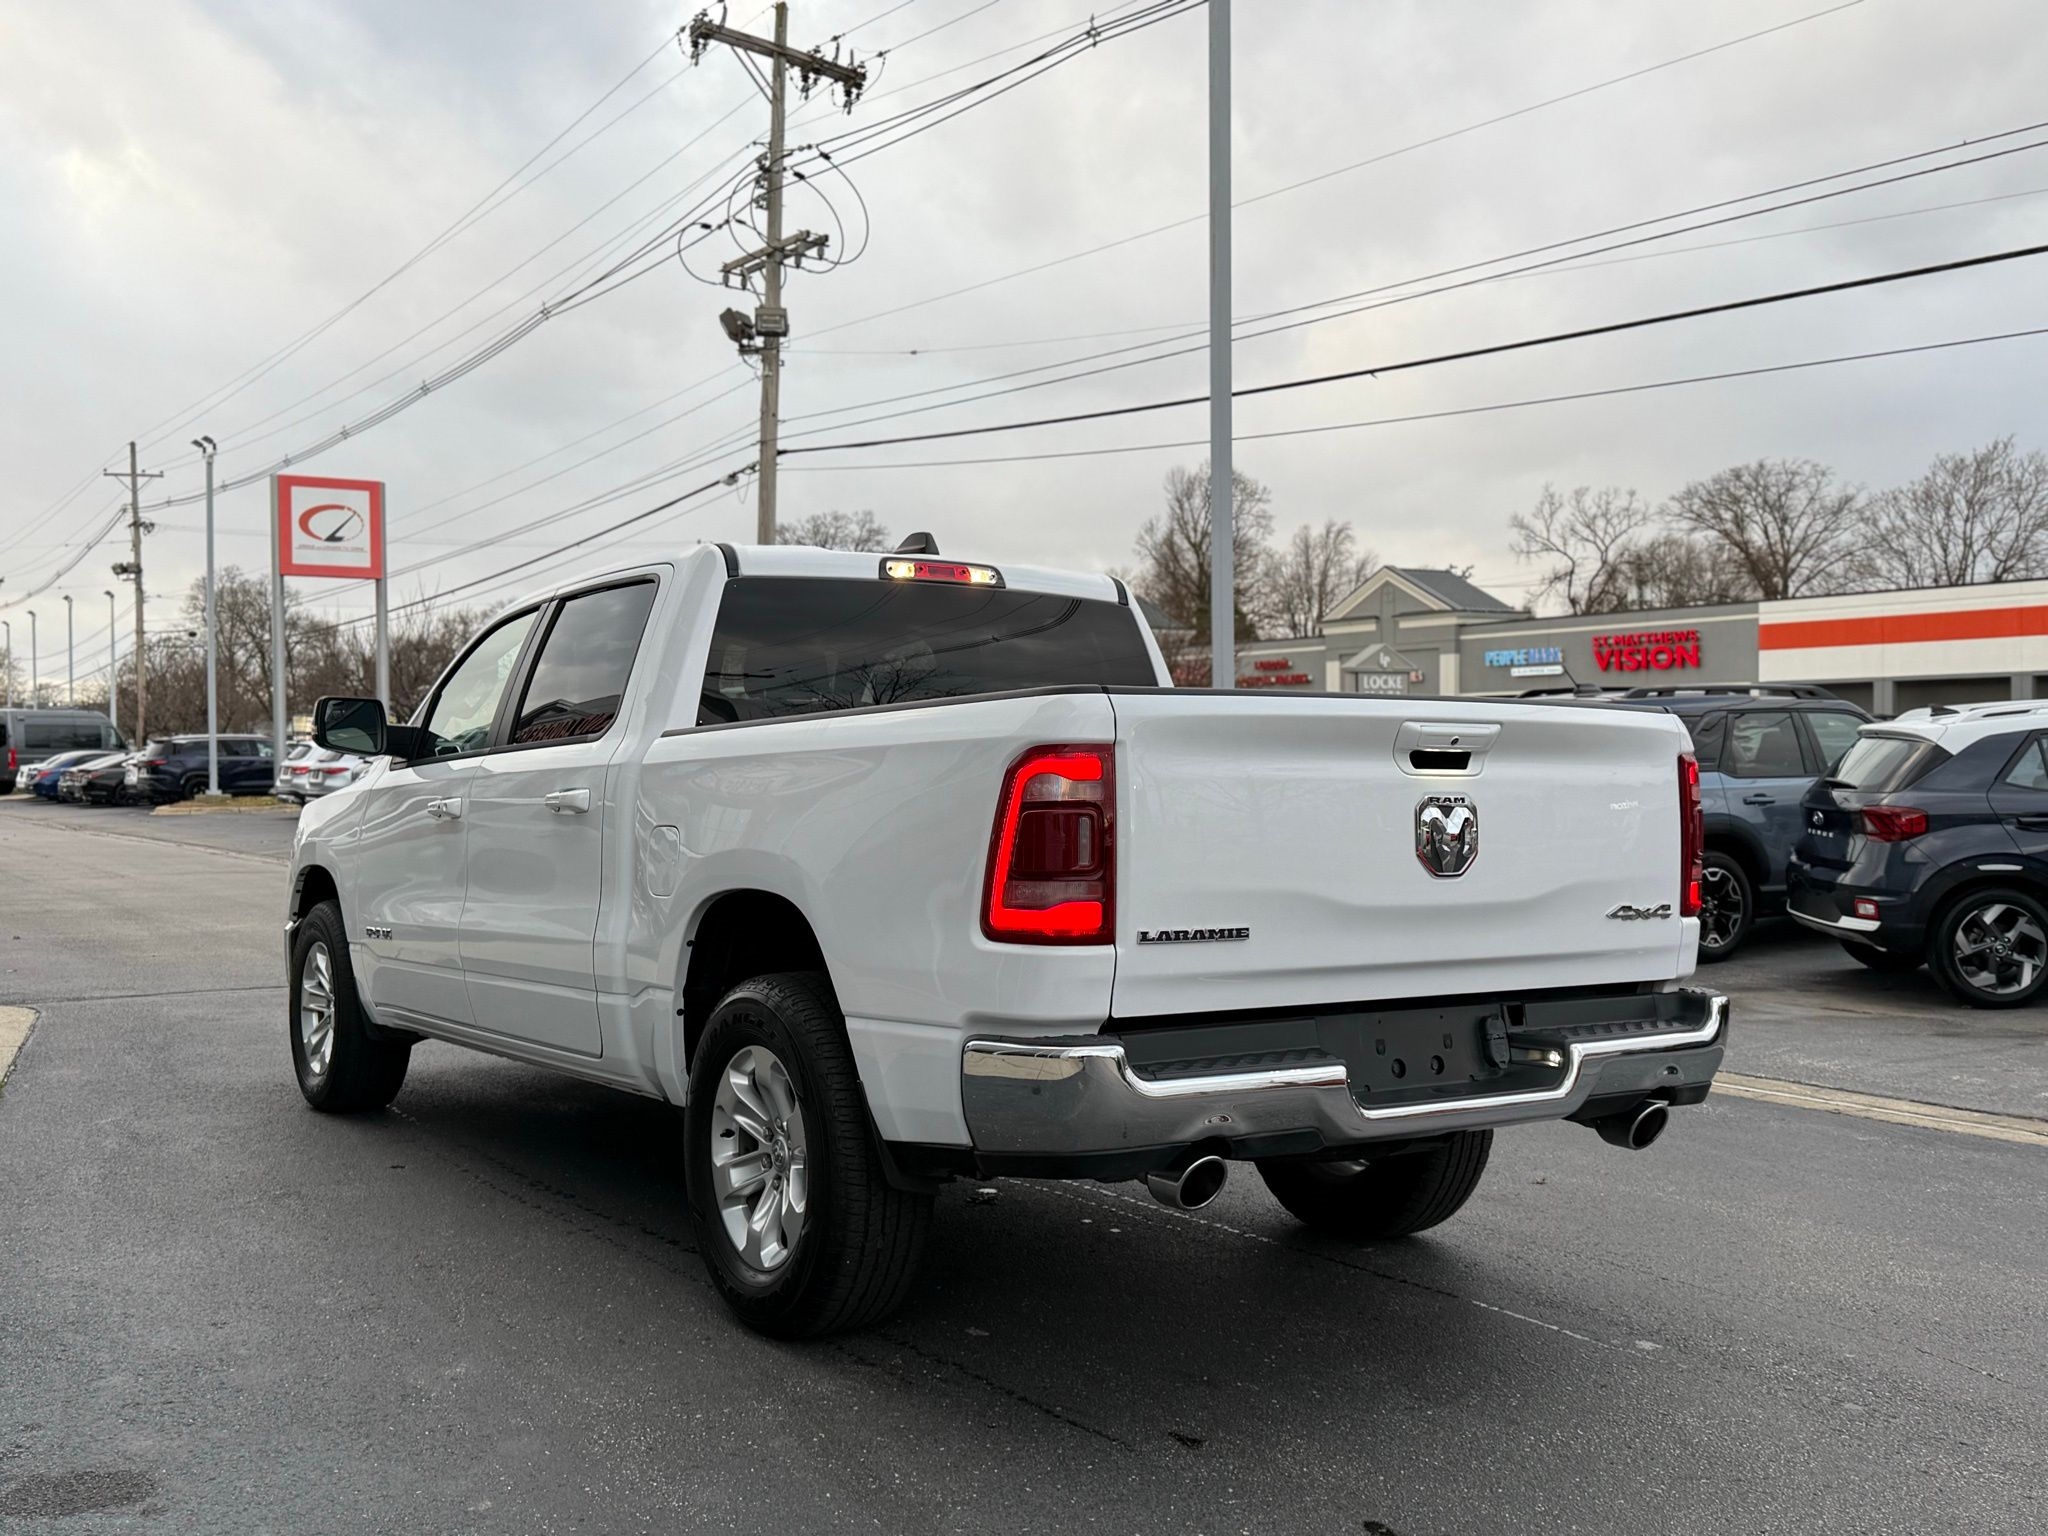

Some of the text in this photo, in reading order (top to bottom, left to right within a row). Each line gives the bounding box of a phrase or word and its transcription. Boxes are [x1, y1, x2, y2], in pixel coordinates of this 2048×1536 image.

[1594, 644, 1700, 672] VISION
[1363, 675, 1403, 690] LOCKE
[1428, 796, 1467, 804] RAM
[1138, 928, 1249, 944] LARAMIE
